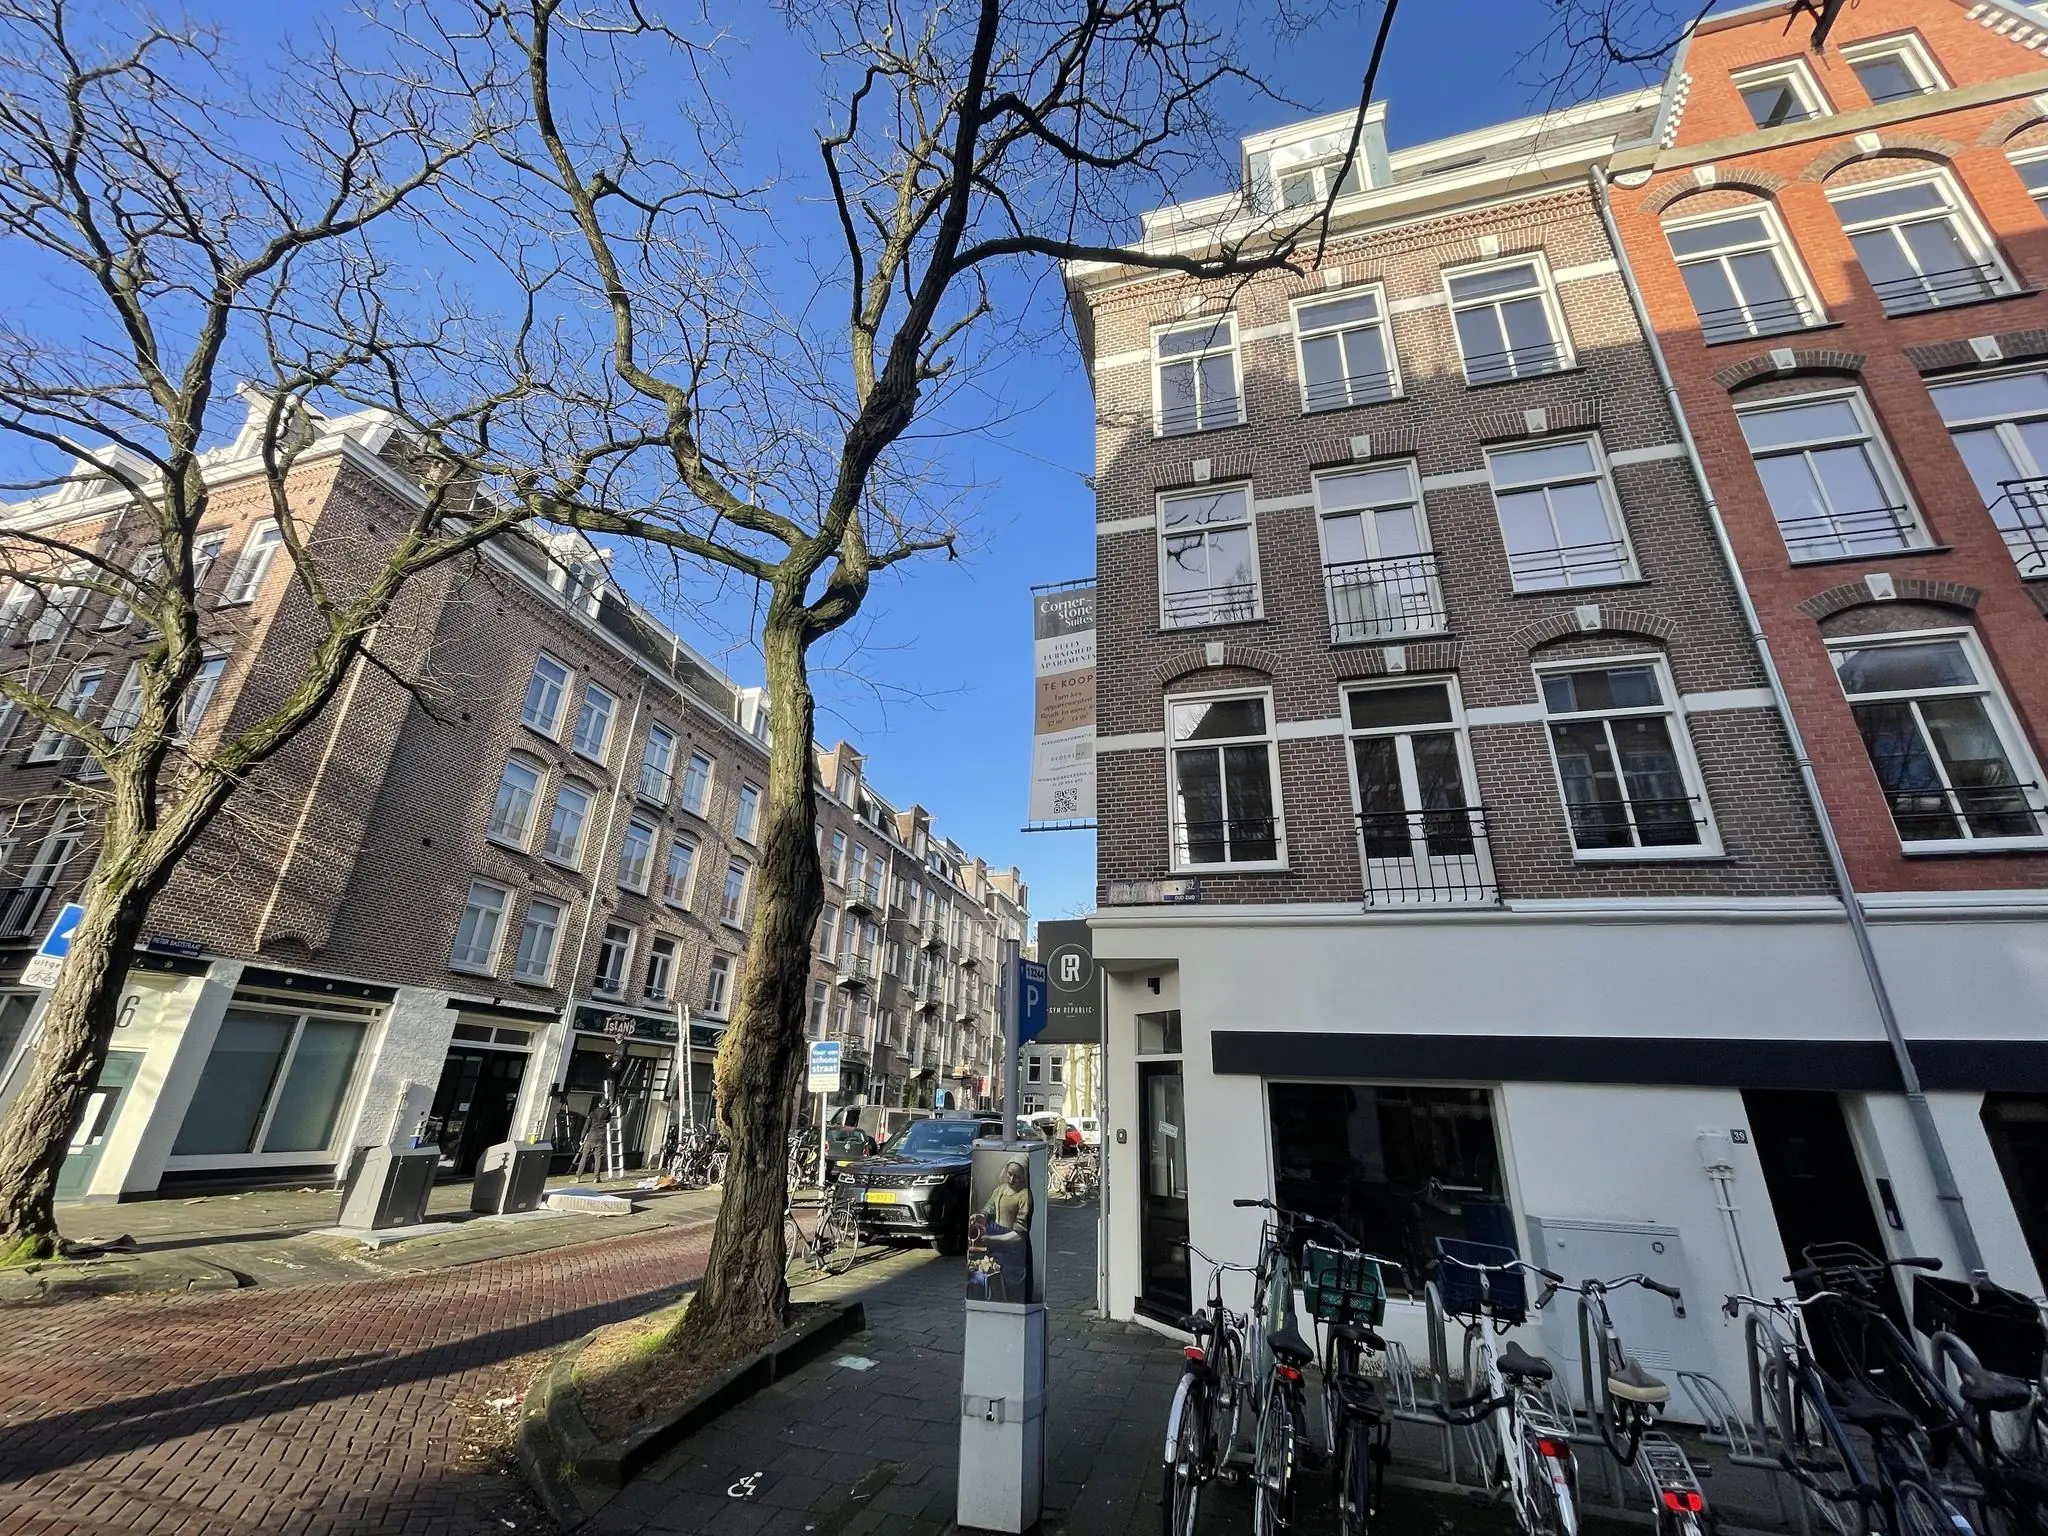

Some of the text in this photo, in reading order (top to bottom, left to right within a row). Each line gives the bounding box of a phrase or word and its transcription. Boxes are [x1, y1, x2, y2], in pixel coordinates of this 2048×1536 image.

[1041, 598, 1092, 613] Corner-
[1059, 606, 1093, 620] stone
[1065, 616, 1093, 627] Suites
[1043, 646, 1092, 660] FURNISHED
[1041, 653, 1096, 669] APARTMENTS
[1043, 674, 1093, 691] TE KOOP
[34, 960, 62, 969] uitge
[1027, 985, 1039, 1018] P
[115, 995, 141, 1028] 6
[1049, 1006, 1092, 1014] GYM REPUBLIC
[604, 1017, 635, 1036] ISLAND
[812, 1056, 838, 1064] schone
[812, 1064, 838, 1073] straat
[1733, 1131, 1745, 1141] 39
